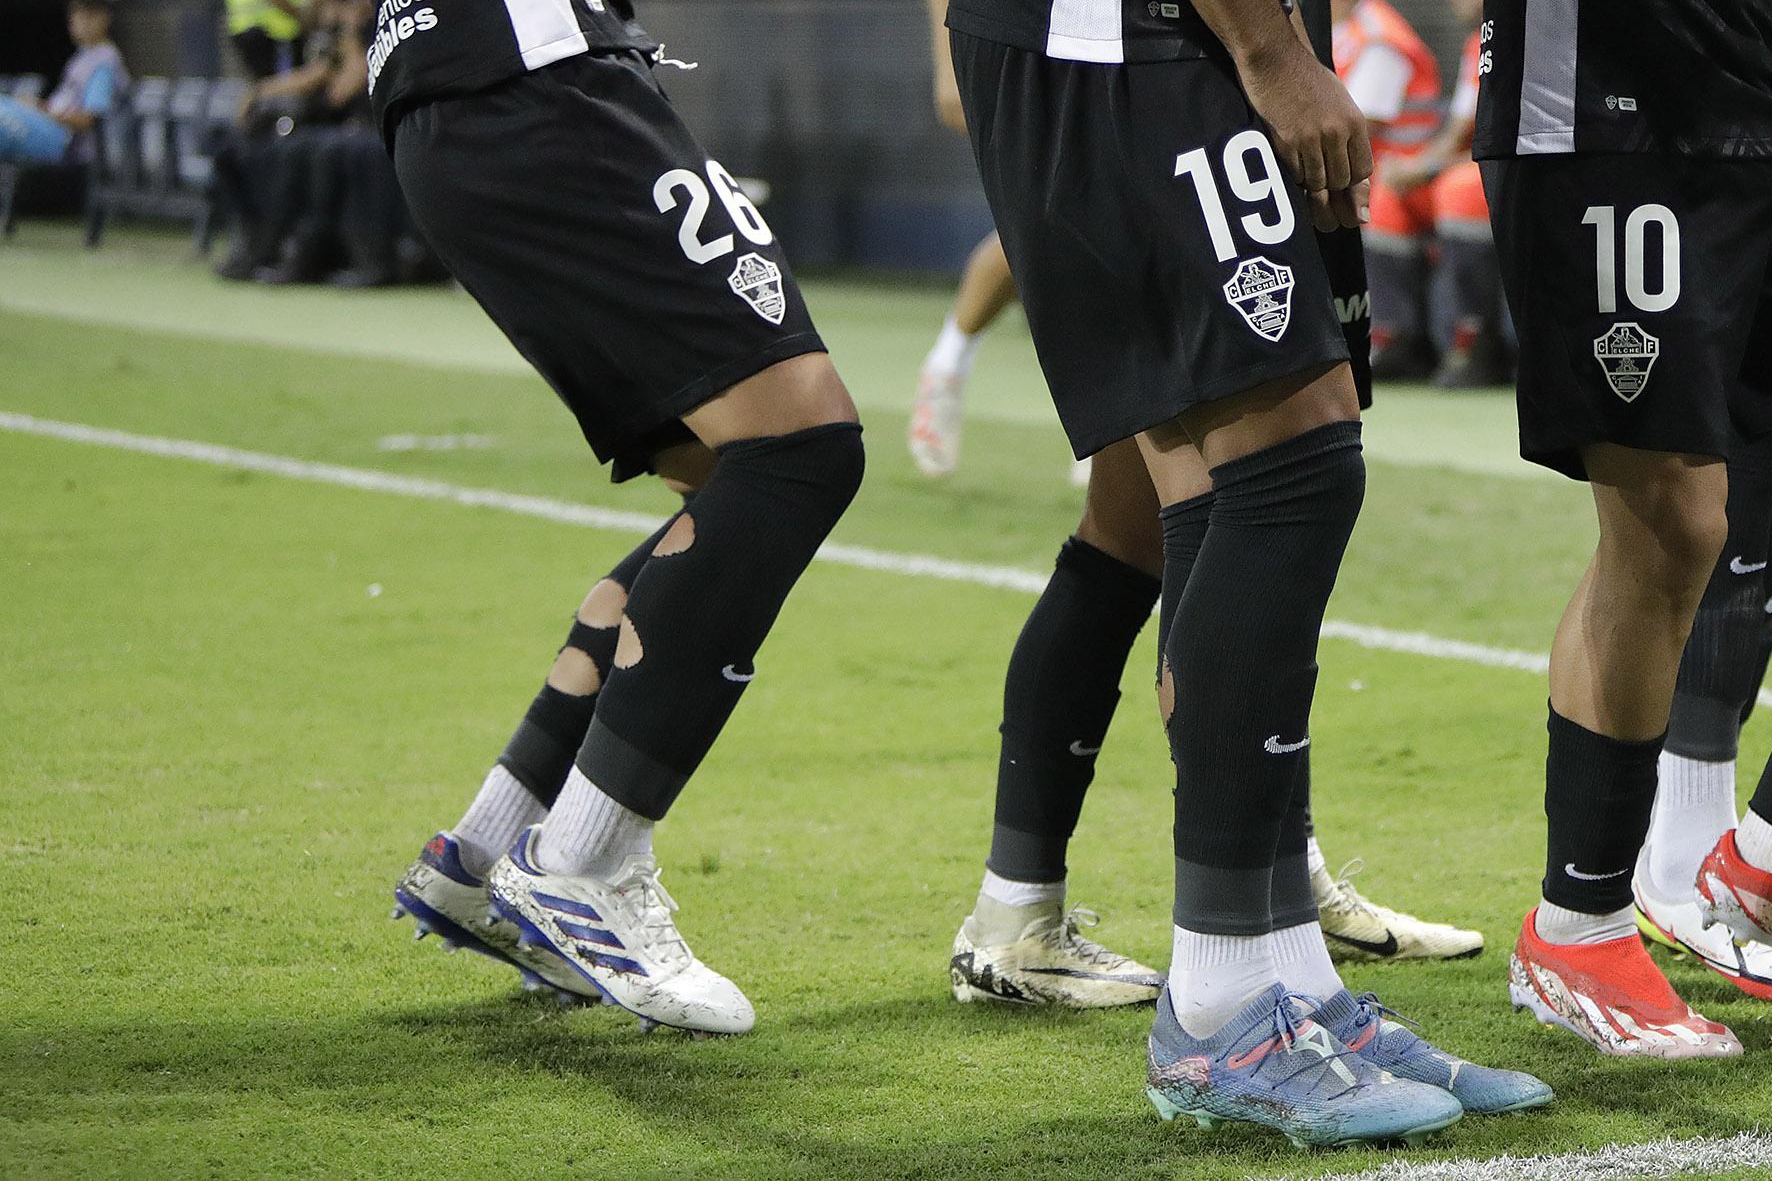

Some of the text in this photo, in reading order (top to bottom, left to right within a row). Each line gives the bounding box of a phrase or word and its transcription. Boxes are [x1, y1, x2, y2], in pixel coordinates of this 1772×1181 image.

[652, 159, 773, 265] 26
[1173, 129, 1296, 263] 19
[1581, 203, 1681, 313] 10
